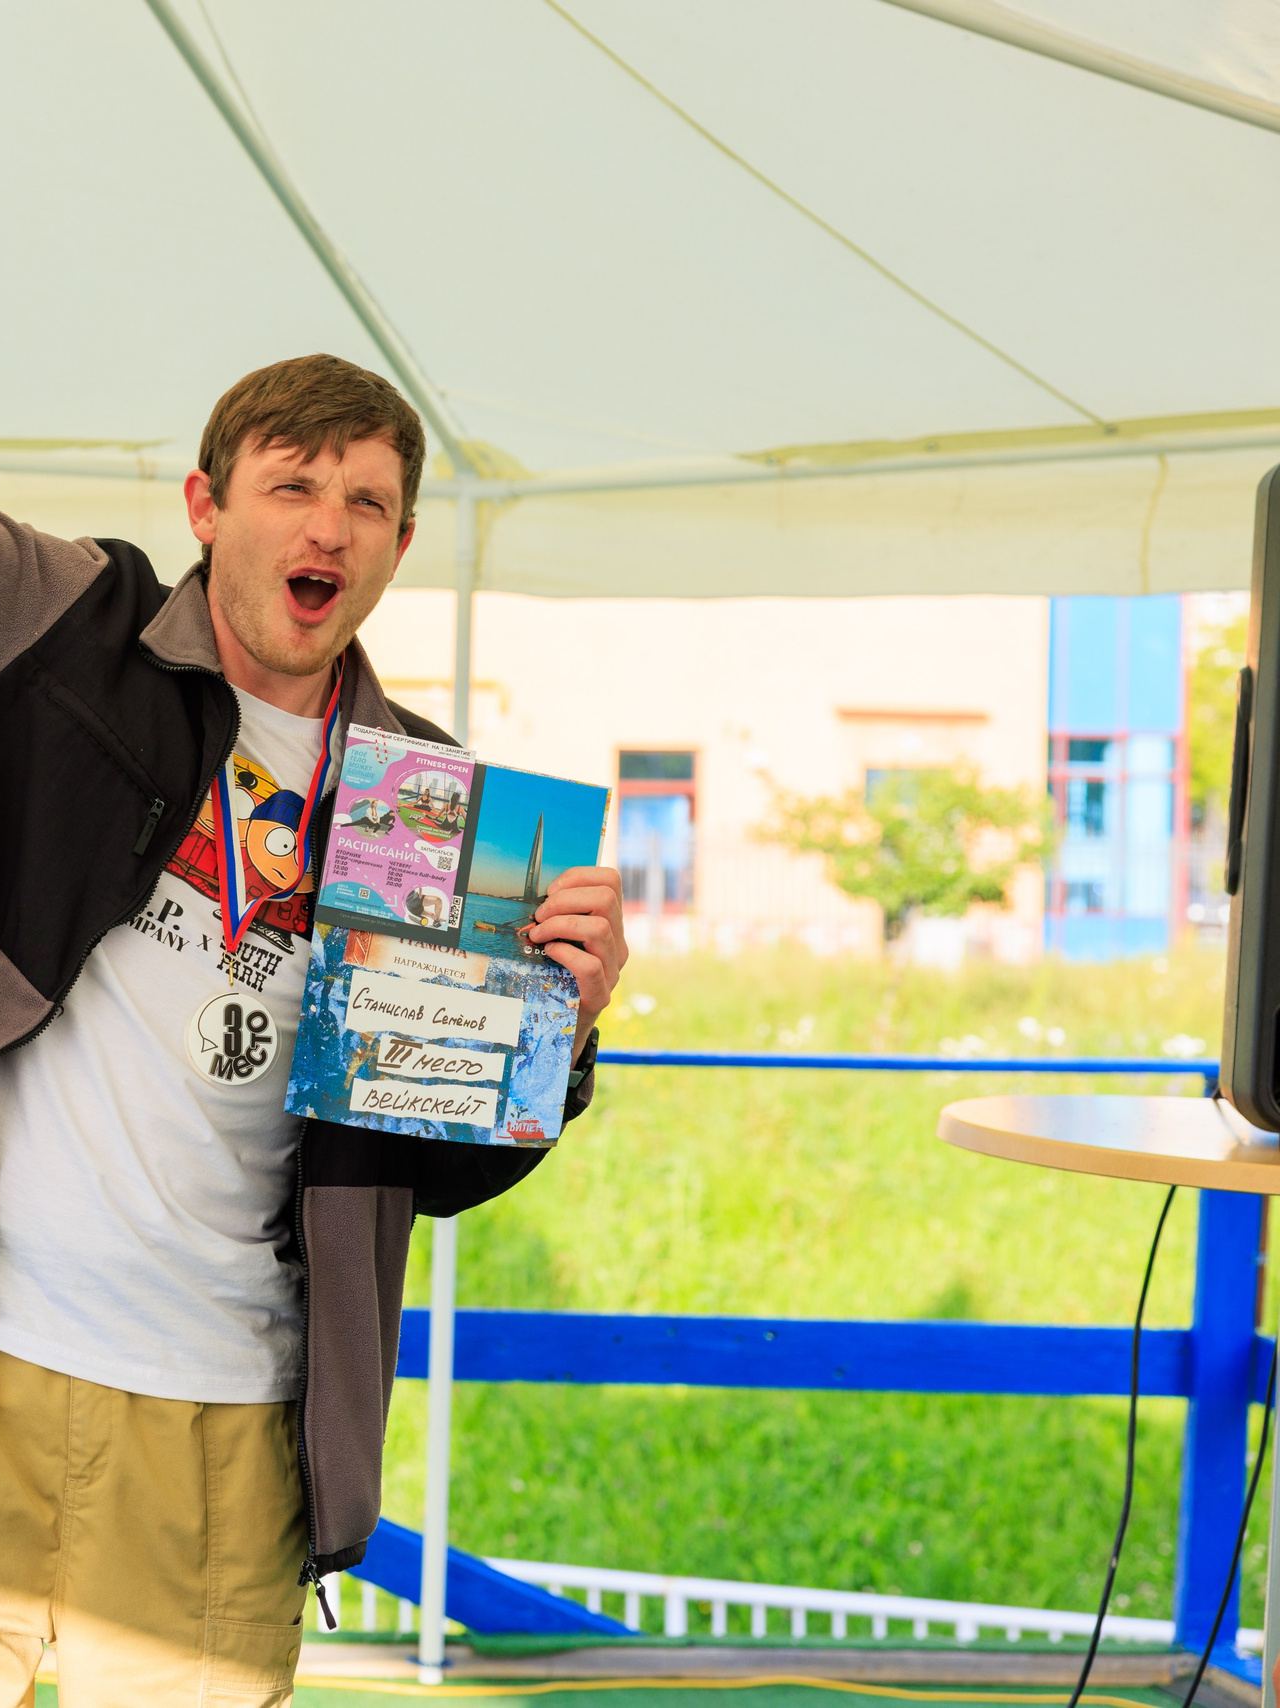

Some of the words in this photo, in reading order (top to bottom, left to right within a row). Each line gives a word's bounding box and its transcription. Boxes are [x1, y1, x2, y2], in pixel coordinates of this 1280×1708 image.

[393, 735, 429, 748] СЕРТИФИКАТ
[444, 747, 471, 757] ЗАНЯТИЕ
[348, 762, 373, 772] МОЖЕТ
[416, 757, 447, 769] FITNESS
[448, 764, 469, 774] OPEN
[335, 849, 362, 858] ВТОРНИК
[337, 836, 422, 864] РАСПИСАНИЕ
[389, 860, 413, 869] ЧЕТВЕРГ
[418, 872, 447, 883] full-body
[146, 898, 184, 931] .P.
[126, 916, 190, 953] MPANY
[196, 933, 213, 952] X
[534, 948, 548, 956] DO
[216, 953, 268, 993] PARK
[393, 955, 467, 980] НАГРАЖДАЕТСЯ
[223, 1002, 244, 1058] 3
[432, 1007, 488, 1031] Семёнов
